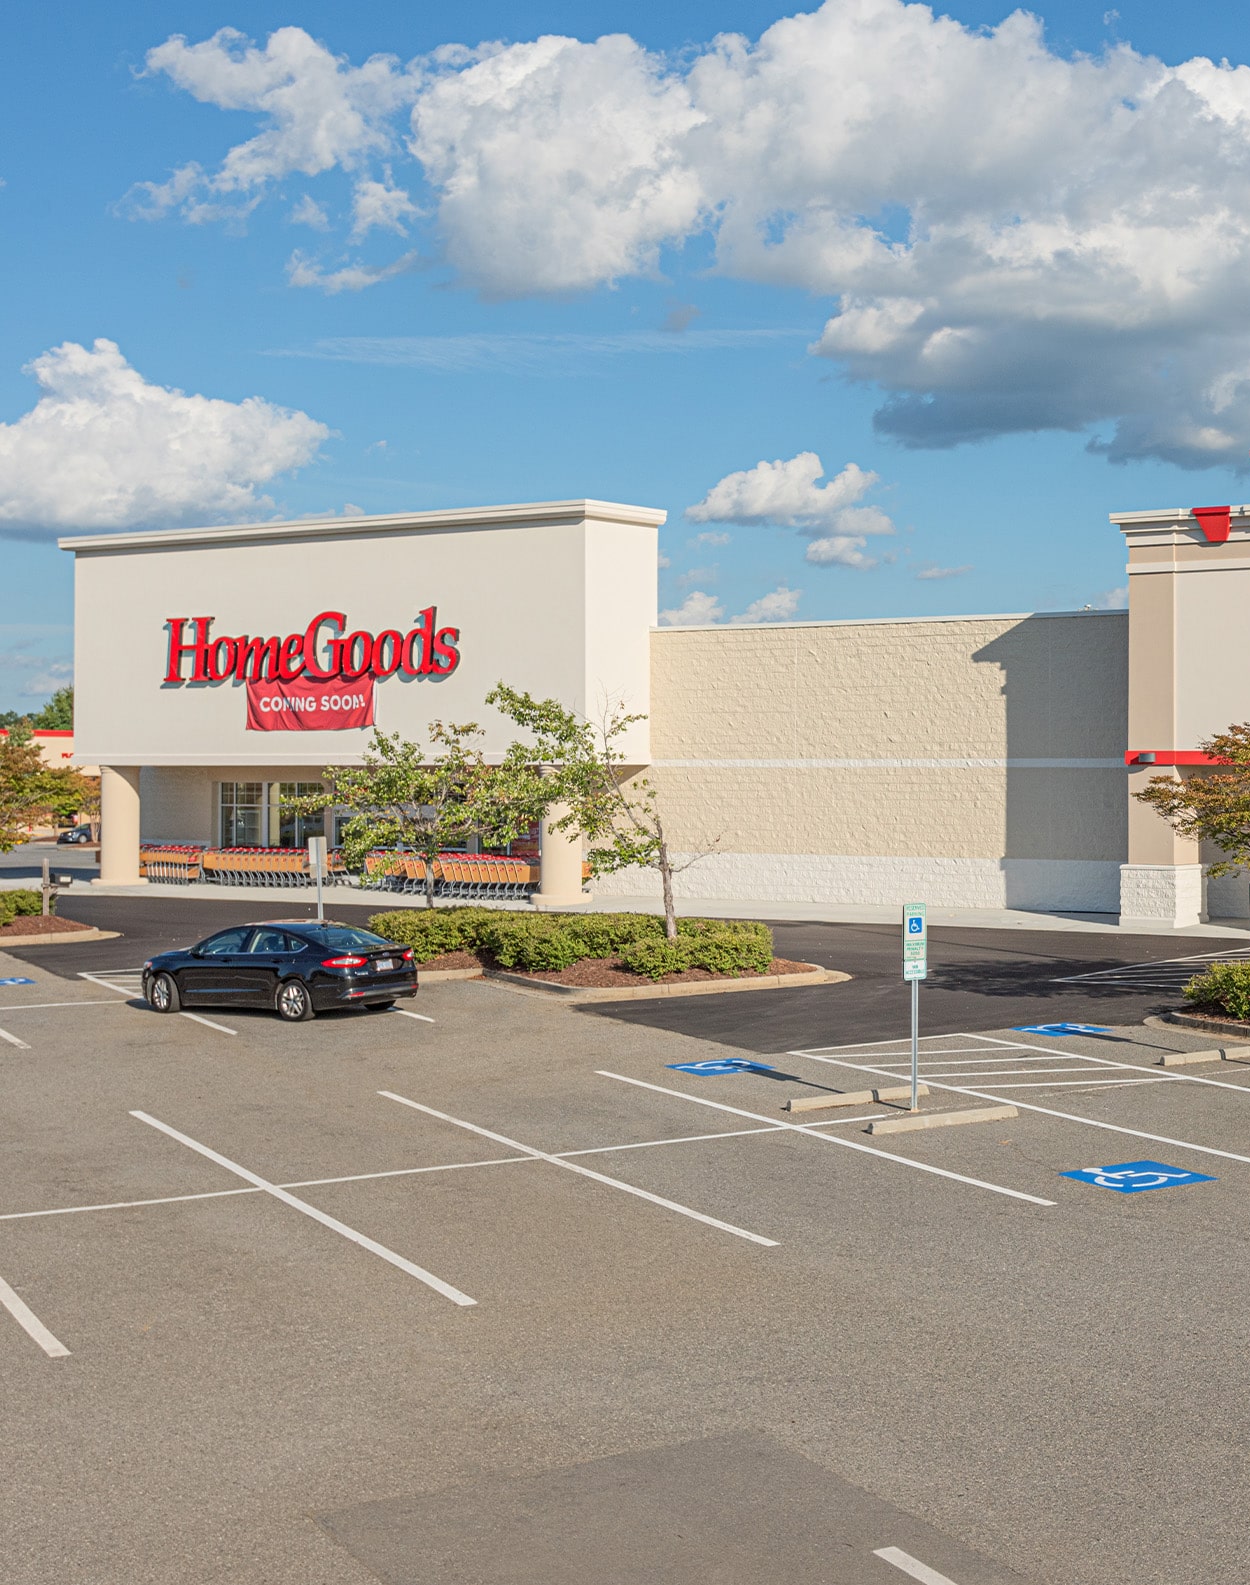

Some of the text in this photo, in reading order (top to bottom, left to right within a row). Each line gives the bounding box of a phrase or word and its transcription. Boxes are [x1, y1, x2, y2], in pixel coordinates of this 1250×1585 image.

[163, 605, 460, 682] HomeGoods
[260, 694, 366, 712] COMING SOON!
